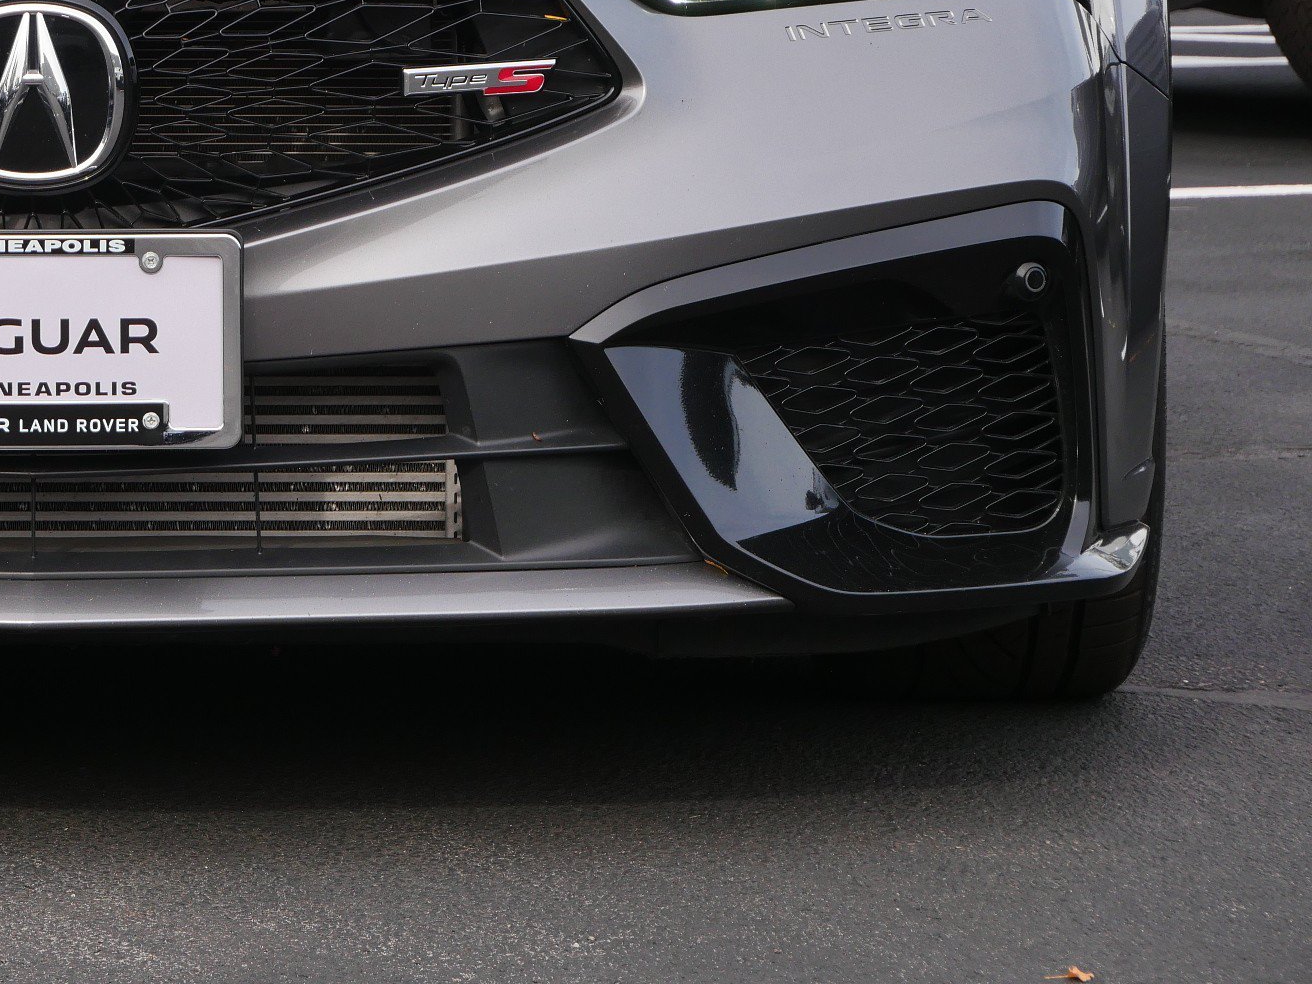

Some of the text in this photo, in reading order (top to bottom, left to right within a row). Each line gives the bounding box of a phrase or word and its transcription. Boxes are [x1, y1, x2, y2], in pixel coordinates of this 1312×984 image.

[784, 8, 993, 42] INTEGRA
[414, 62, 555, 96] Type S
[19, 417, 72, 433] LAND
[76, 417, 140, 433] ROVER
